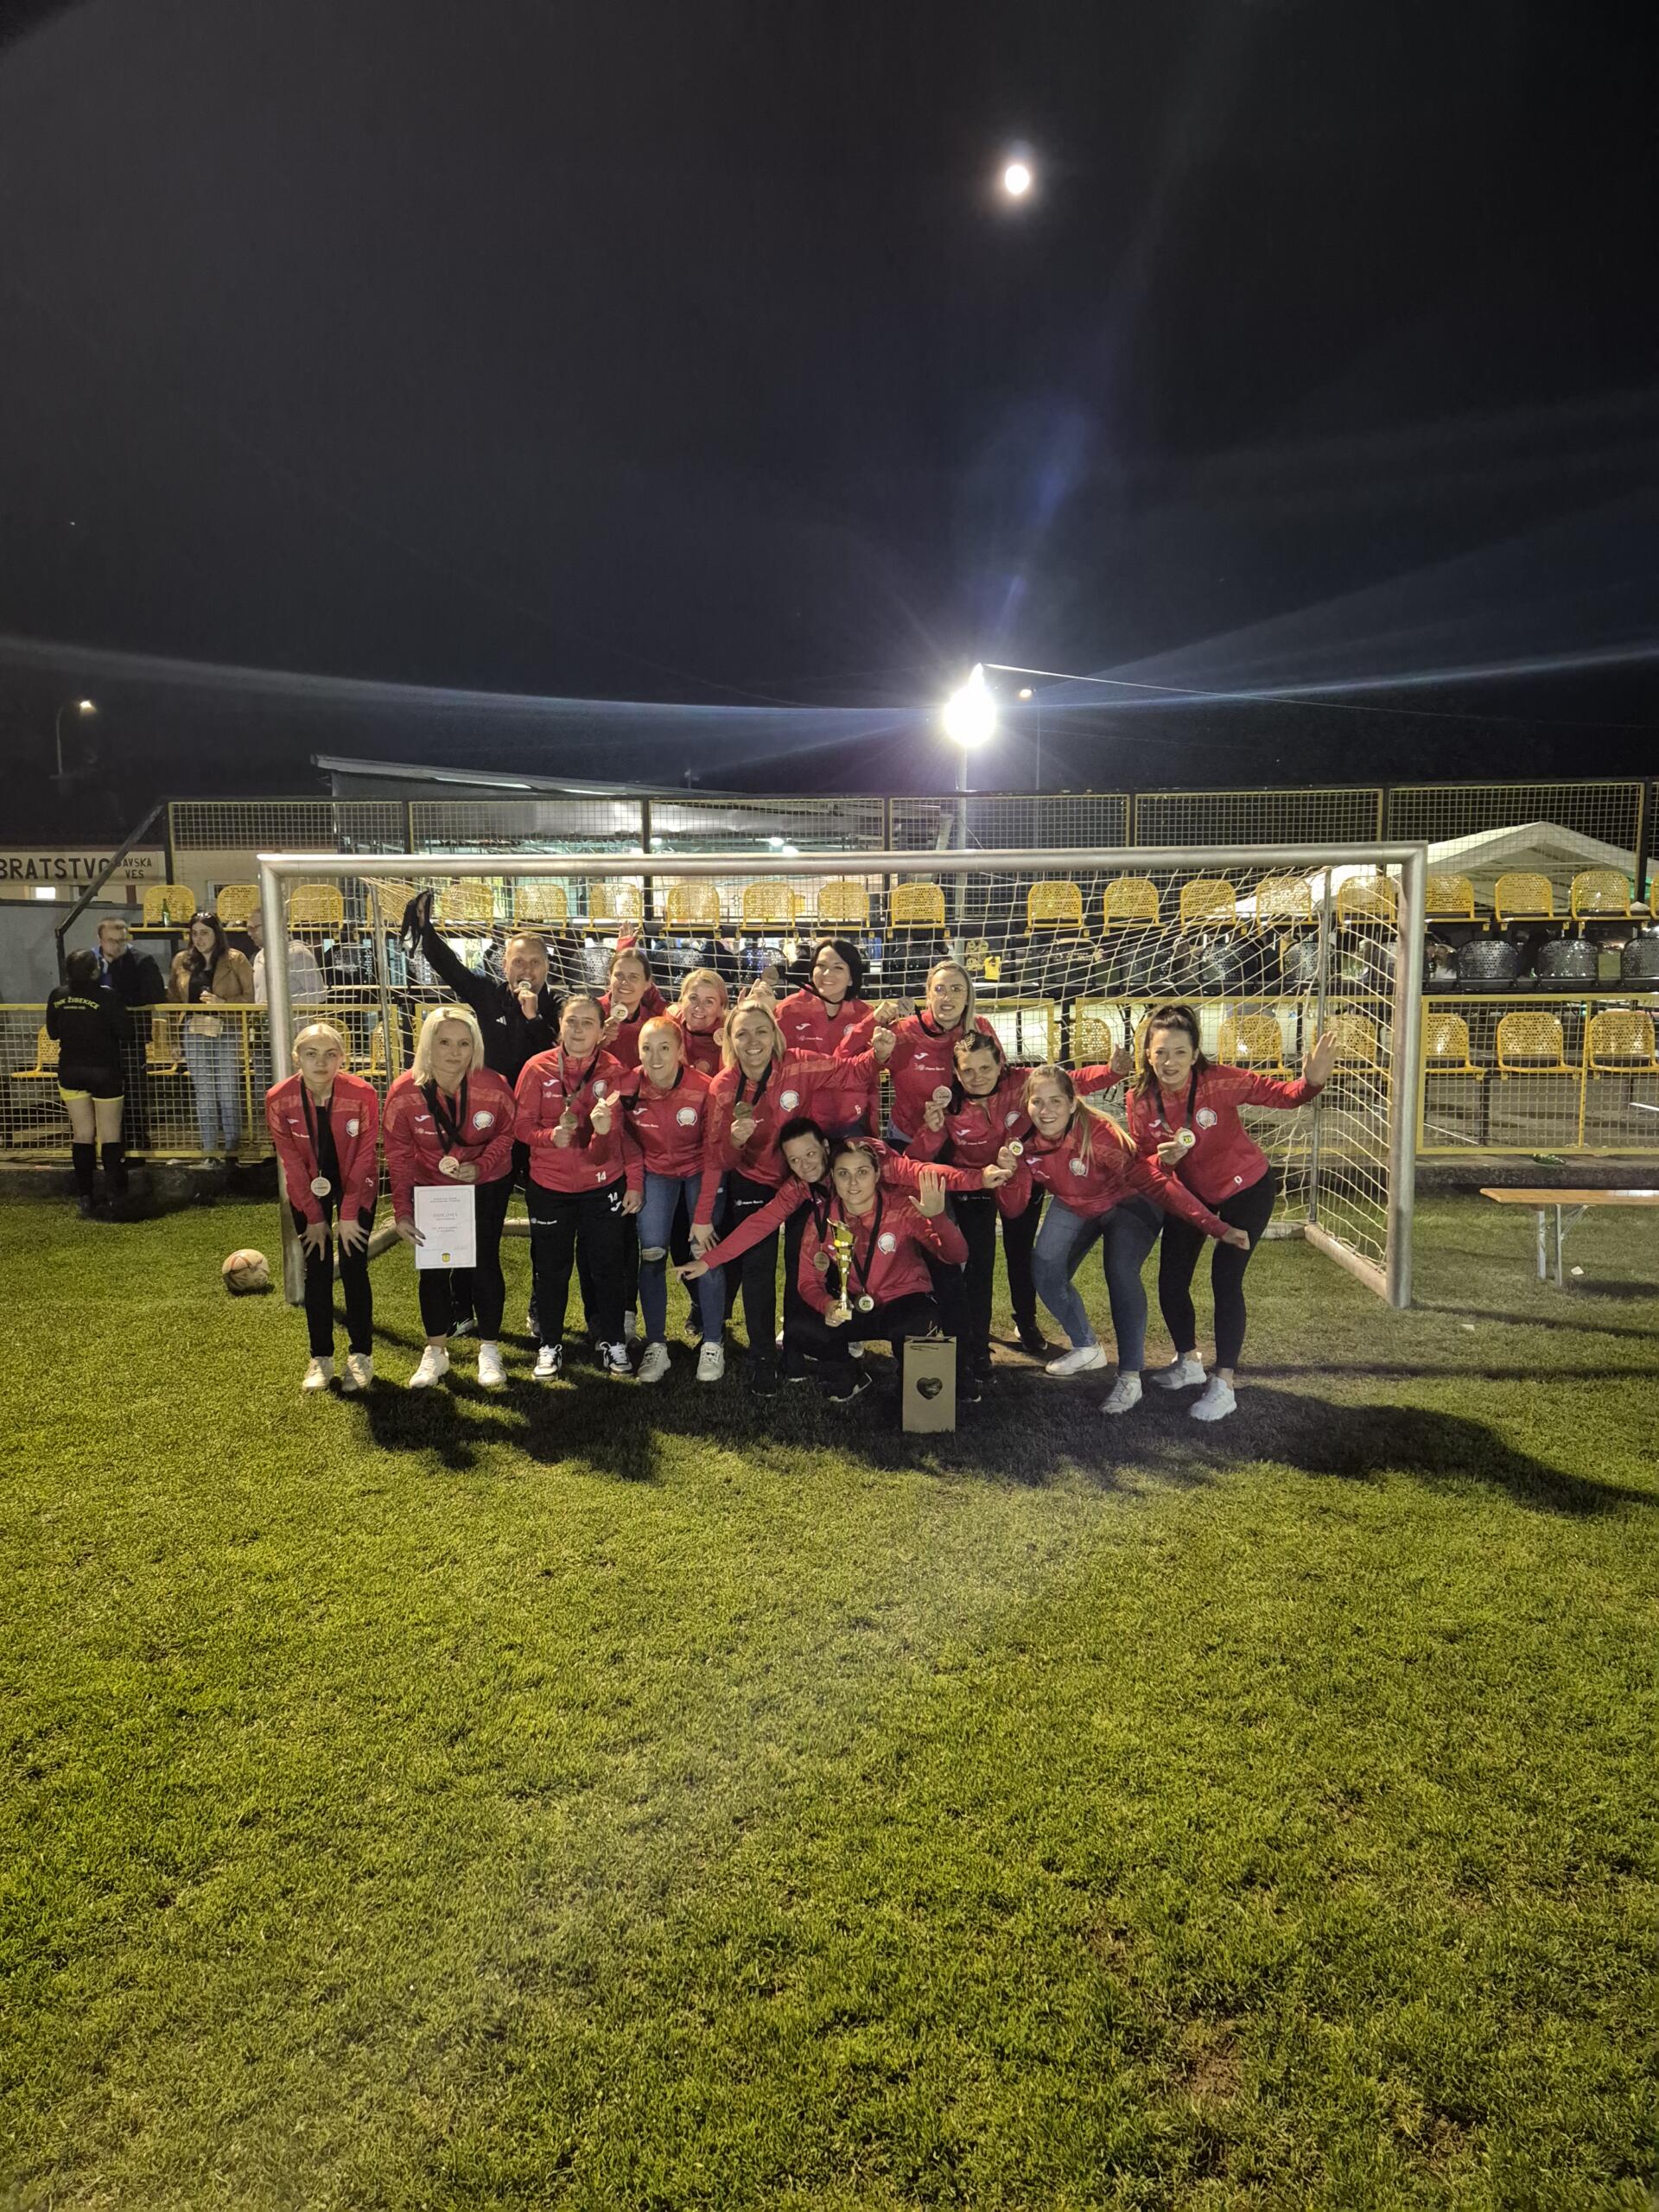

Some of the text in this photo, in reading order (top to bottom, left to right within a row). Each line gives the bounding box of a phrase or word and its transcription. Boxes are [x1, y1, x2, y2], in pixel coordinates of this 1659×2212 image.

[116, 857, 152, 868] AVSKA
[124, 869, 145, 879] VES
[595, 1171, 607, 1183] 14
[607, 1192, 619, 1204] 14
